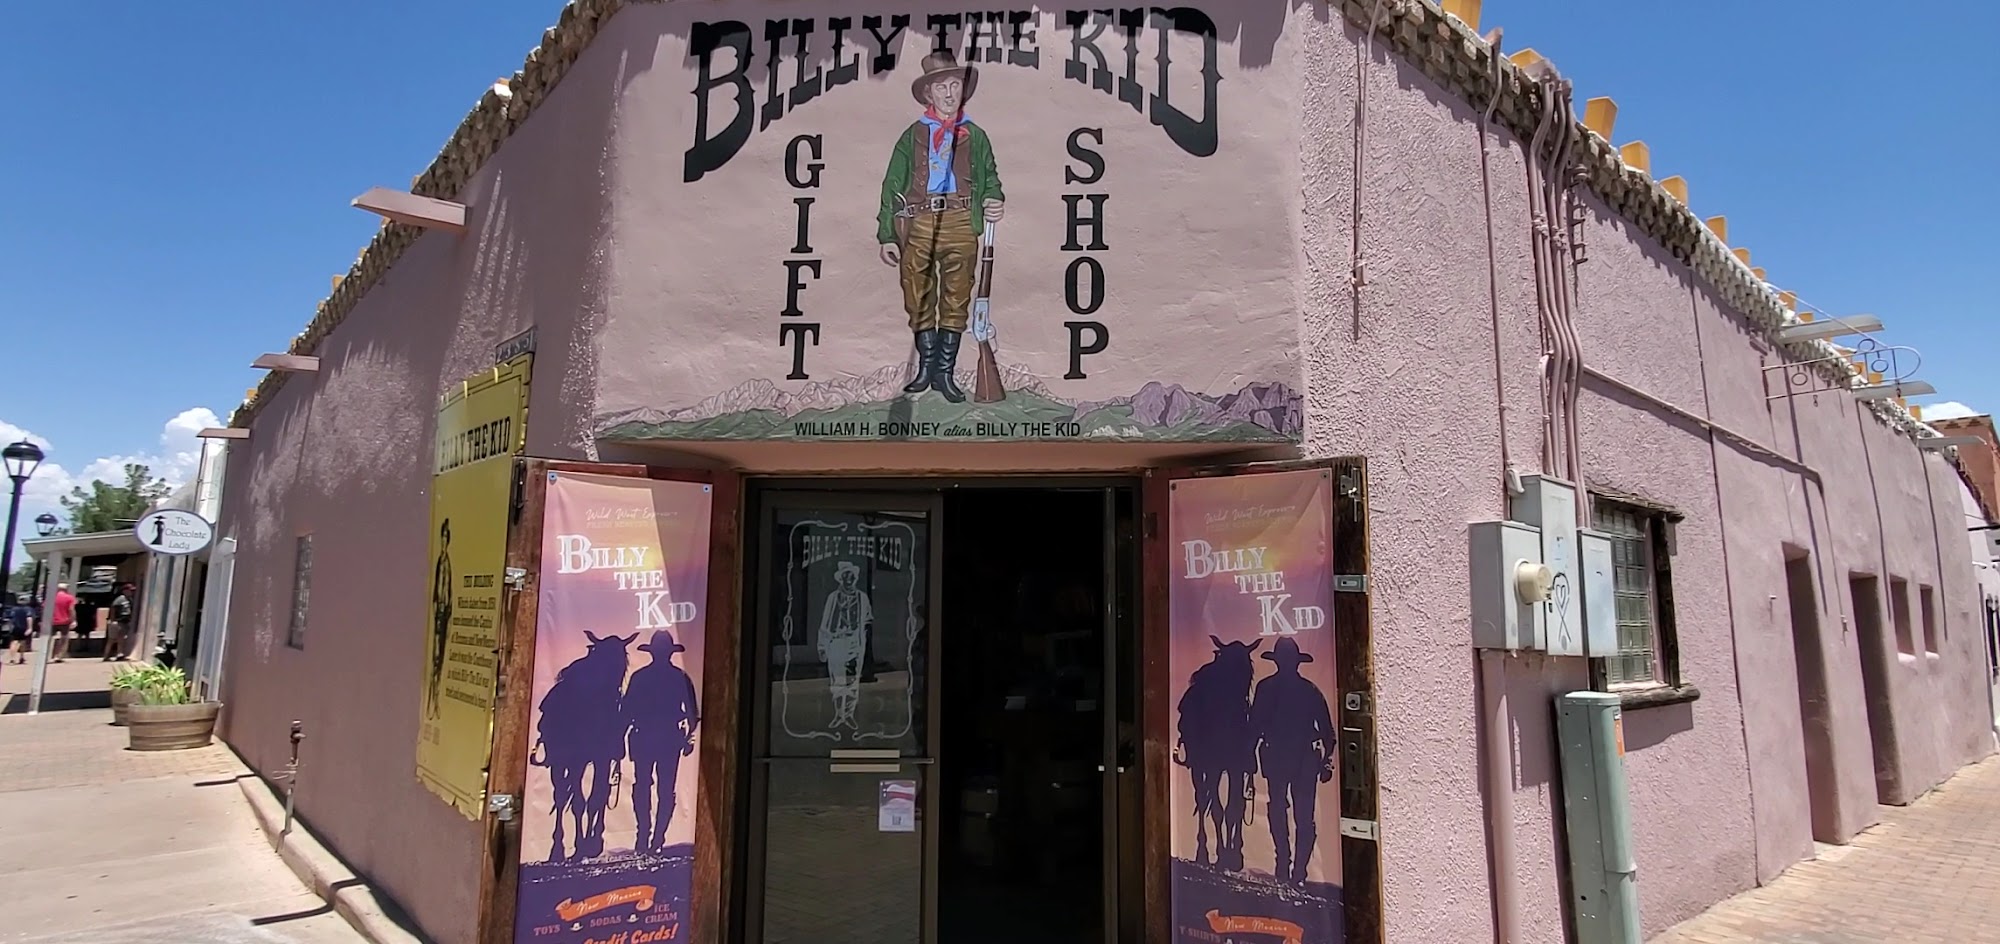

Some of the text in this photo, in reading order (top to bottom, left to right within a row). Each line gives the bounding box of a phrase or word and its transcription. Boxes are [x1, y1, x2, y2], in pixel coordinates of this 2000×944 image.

[683, 7, 1224, 183] BILLY THE KID
[779, 133, 826, 381] GIFT
[1059, 127, 1110, 380] SHOP
[794, 422, 1081, 437] WILLIAM H. BONNEY alias BILLY THE KID
[440, 415, 511, 473] BILLY THE KID
[175, 516, 191, 526] The
[585, 507, 612, 521] Wild
[1204, 509, 1229, 525] Wild
[164, 527, 207, 539] Chocolate
[168, 540, 190, 550] Lady
[802, 535, 902, 571] BILLY THE KID
[613, 569, 664, 590] THE
[1234, 571, 1285, 594] THE
[635, 590, 697, 629] KID
[1256, 593, 1325, 636] KID
[576, 901, 600, 915] New
[654, 903, 670, 913] ICE
[589, 912, 679, 928] SODAS CREAM
[1223, 919, 1245, 931] New
[533, 924, 561, 936] TOYS
[631, 922, 680, 944] Cards!
